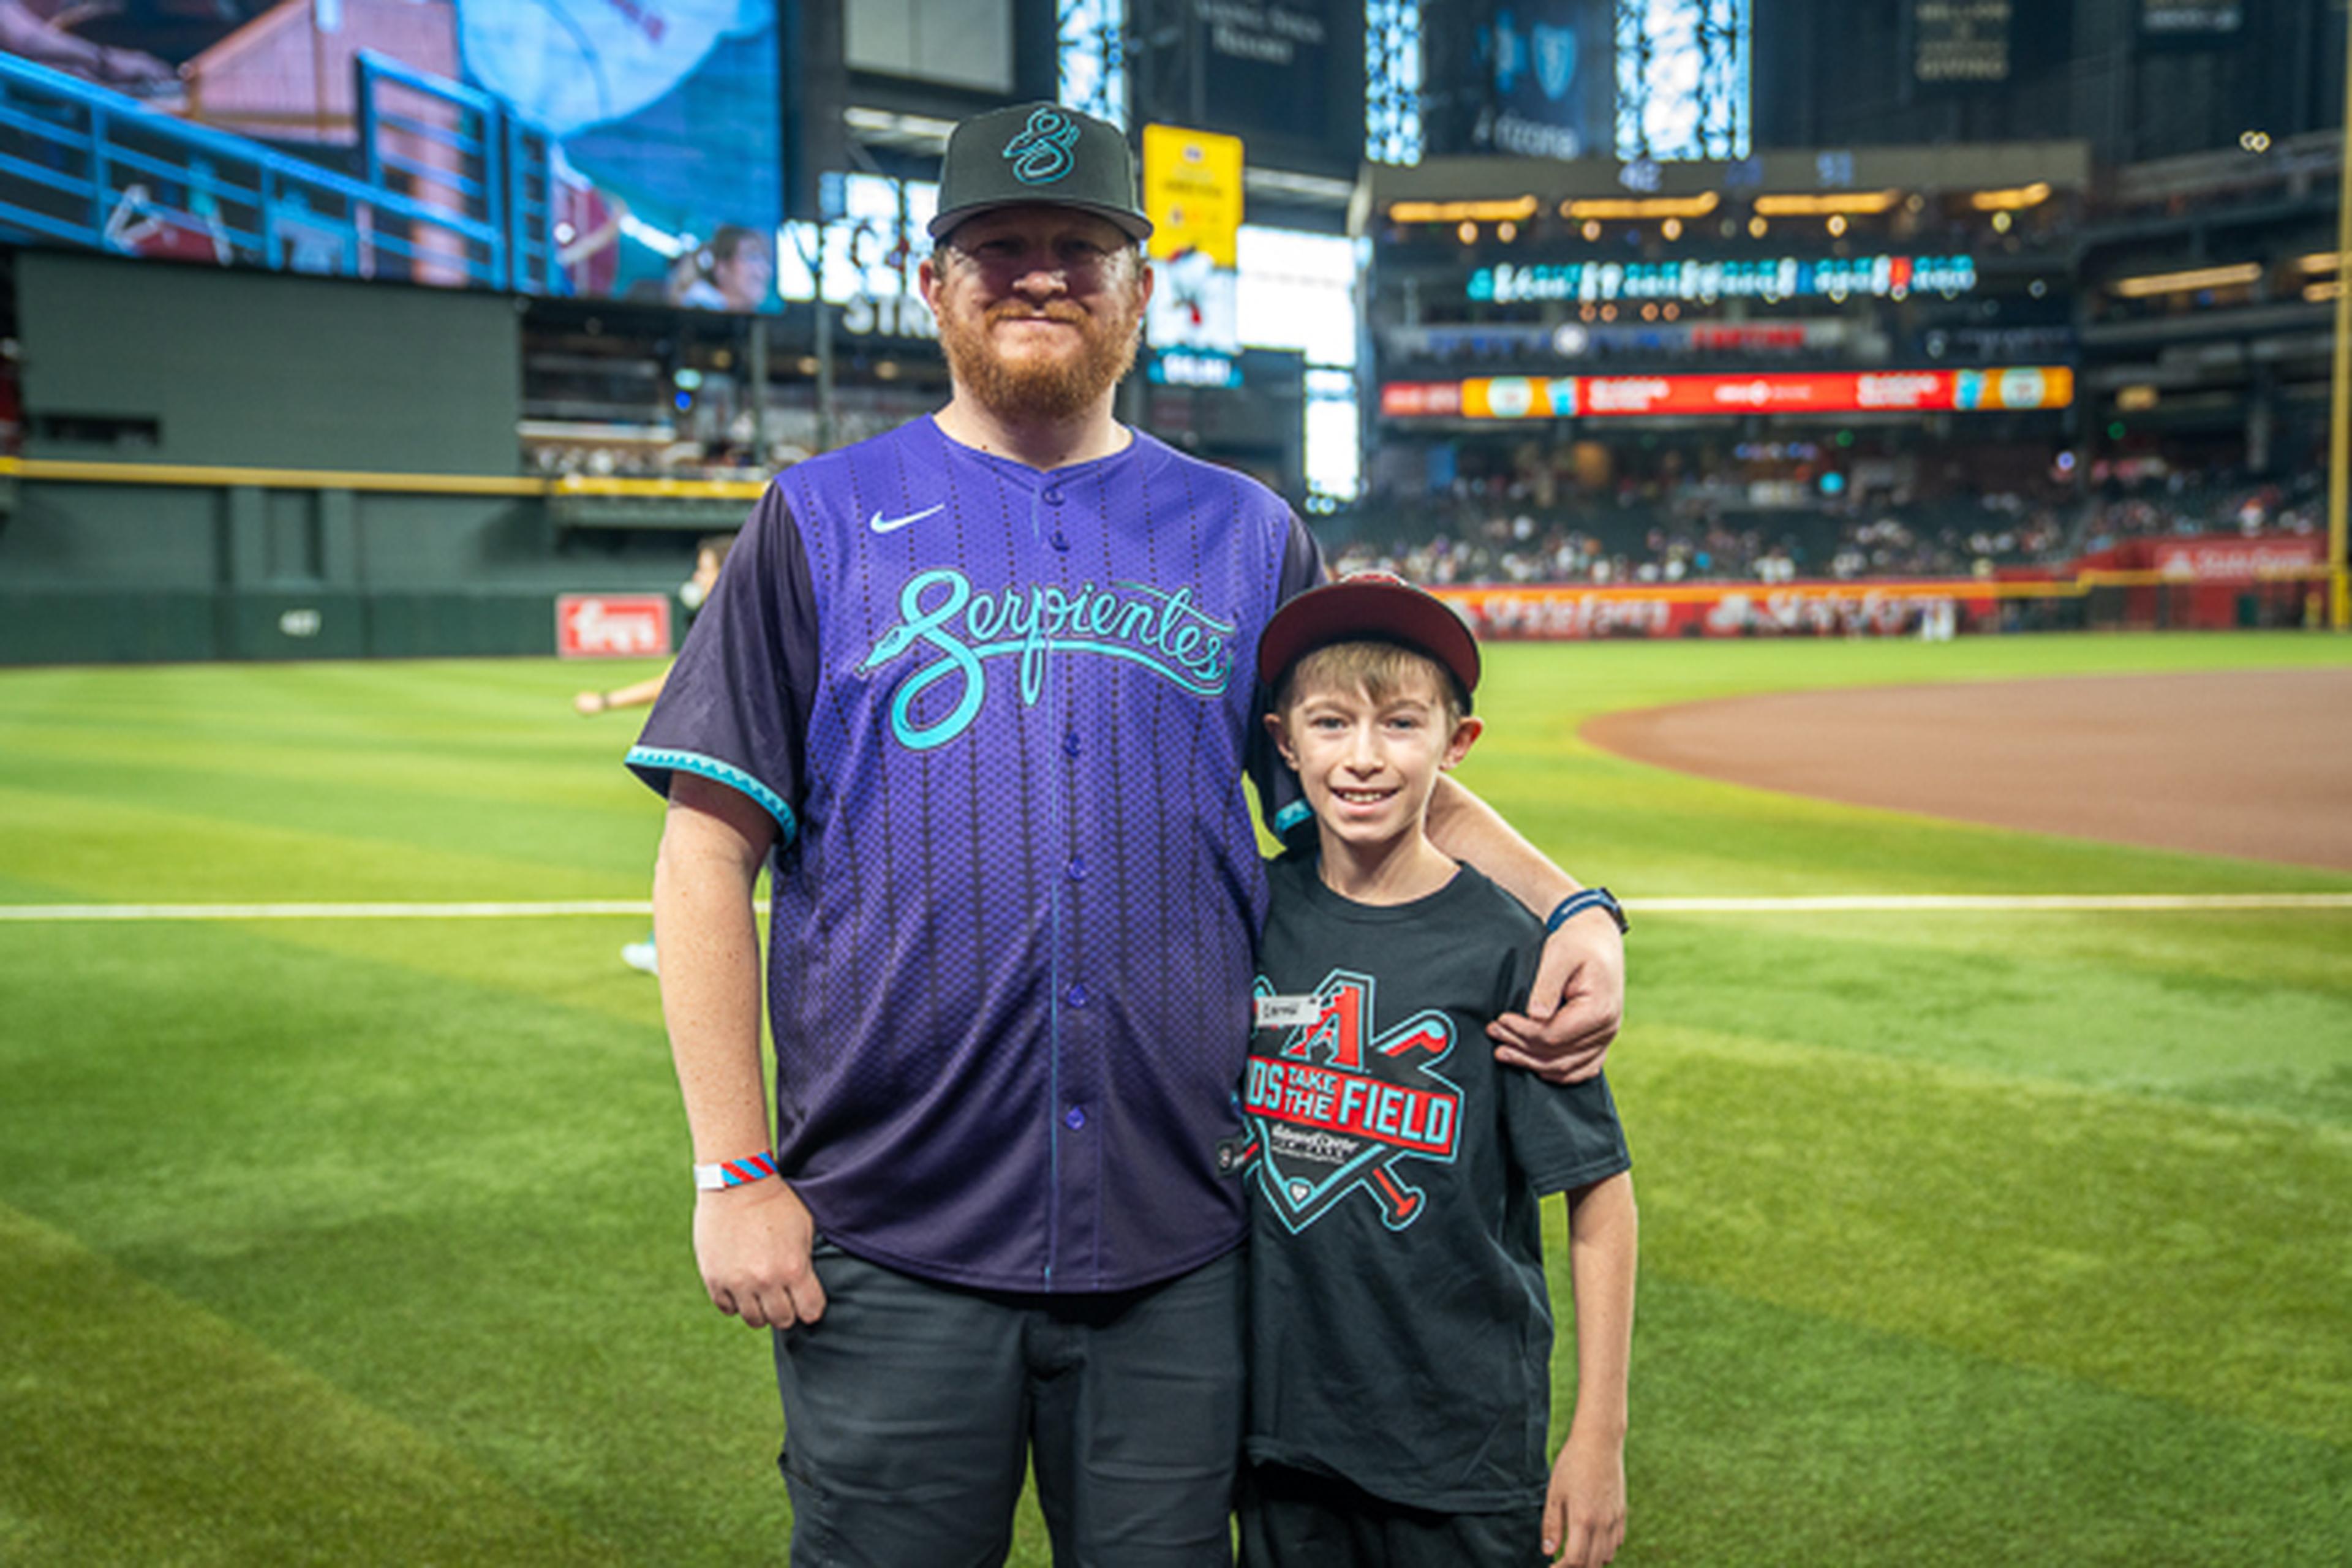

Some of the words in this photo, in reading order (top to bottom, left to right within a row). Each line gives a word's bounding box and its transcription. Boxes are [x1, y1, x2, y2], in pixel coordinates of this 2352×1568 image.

[858, 568, 1235, 751] Serpientes
[1247, 1060, 1284, 1110] DS
[1284, 1087, 1333, 1121] THE
[1289, 1067, 1338, 1095] TAKE
[1338, 1080, 1452, 1145] FIELD
